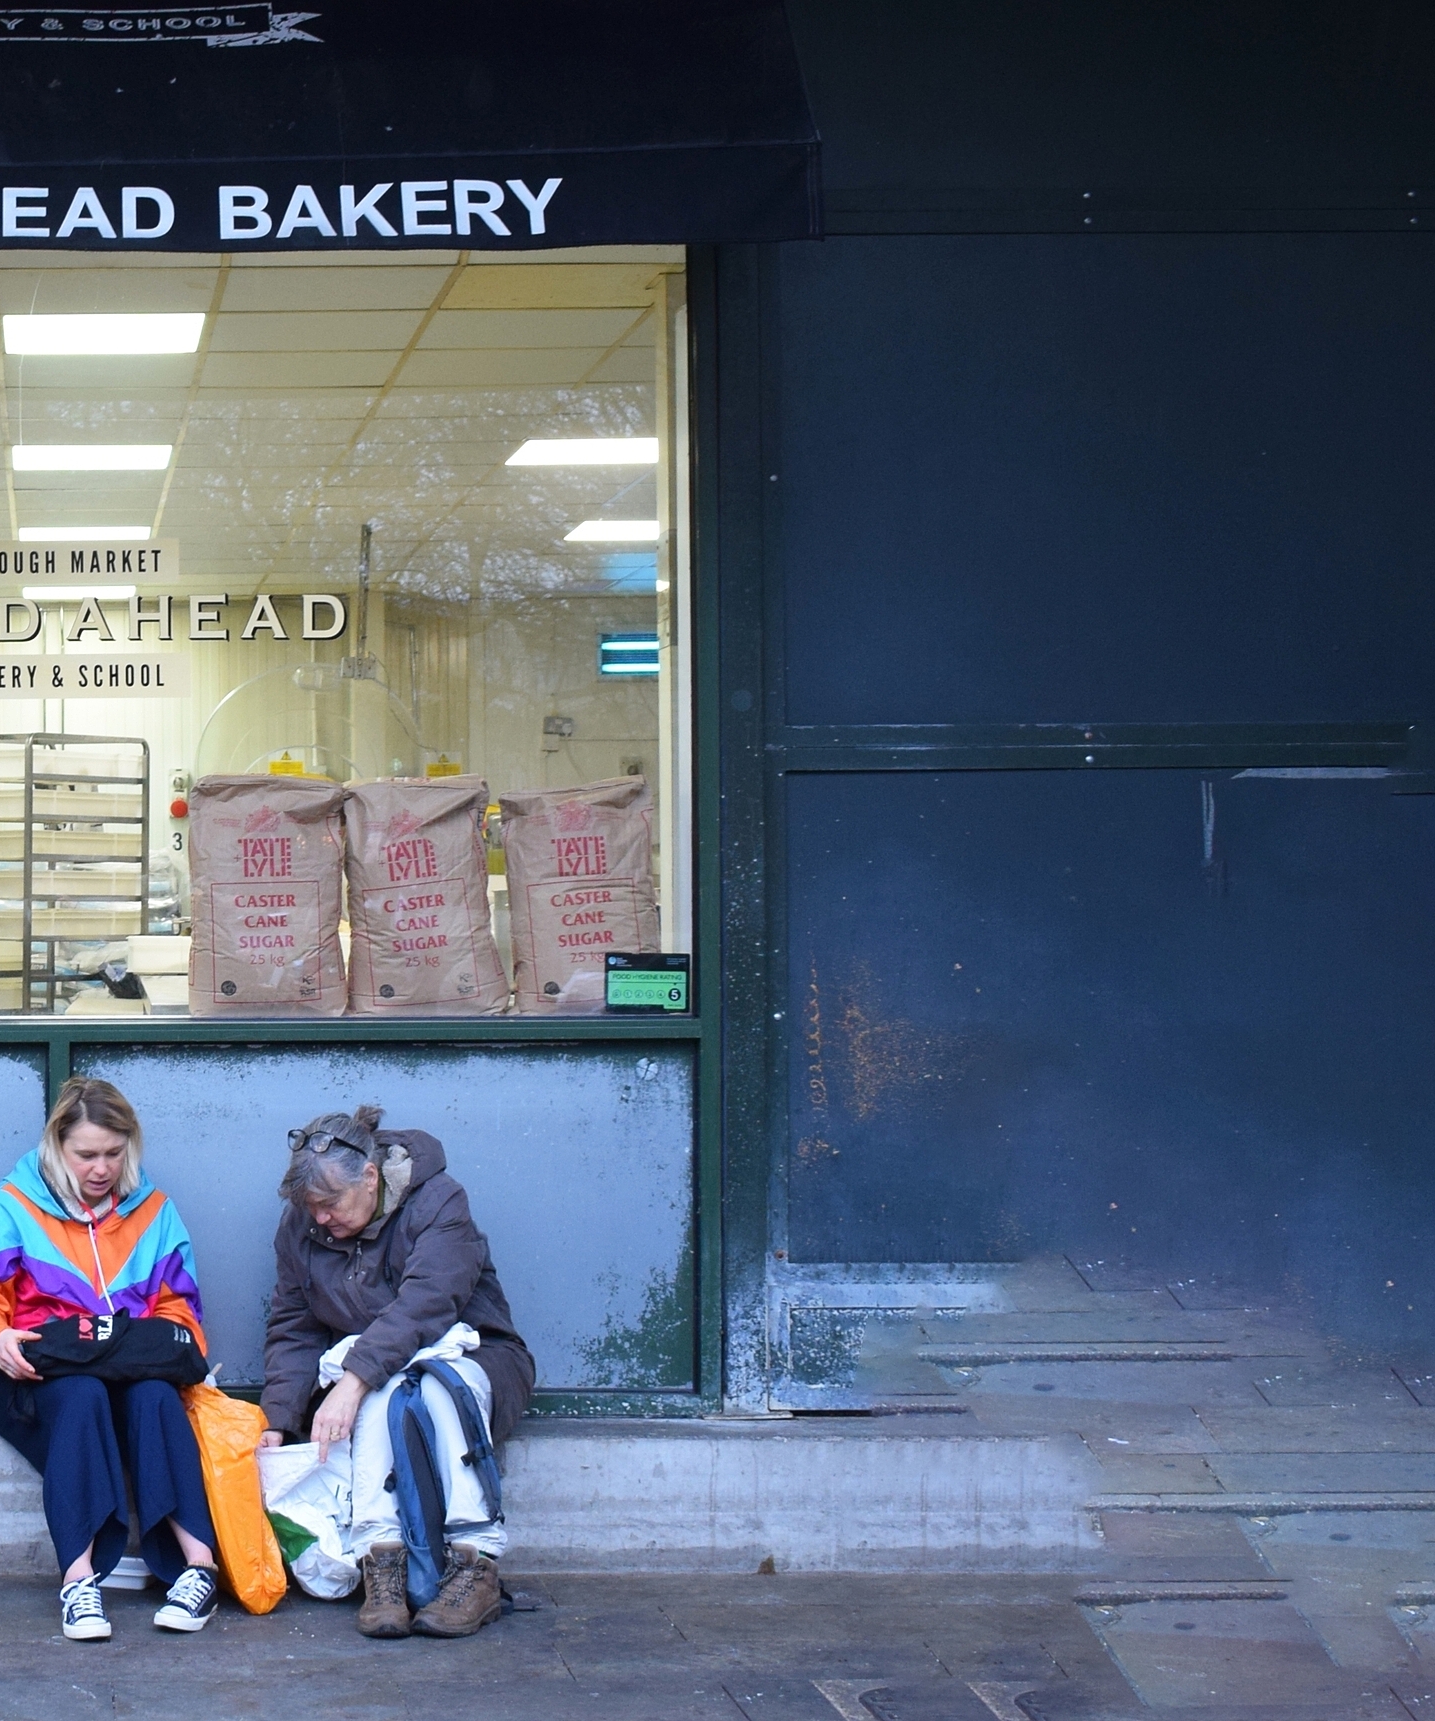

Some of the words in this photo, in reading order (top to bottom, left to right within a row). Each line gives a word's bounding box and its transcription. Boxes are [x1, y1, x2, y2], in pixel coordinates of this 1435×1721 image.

[41, 18, 64, 31] &
[82, 15, 246, 31] SCHOOL
[219, 178, 563, 240] BAKERY
[70, 549, 163, 574] MARKET
[67, 593, 347, 643] AHEAD
[51, 665, 64, 688] &
[78, 663, 166, 688] SCHOOL
[172, 832, 183, 851] 3
[238, 838, 291, 857] TATE
[381, 838, 435, 862] TATE
[551, 836, 605, 856] TATE
[243, 858, 292, 877] LYLE
[388, 857, 437, 881] LYLE
[557, 855, 607, 877] LYLE
[234, 894, 296, 908] CASTER
[383, 894, 446, 913] CASTER
[550, 890, 613, 907] CASTER
[244, 915, 288, 928] CANE
[395, 915, 439, 932] CANE
[561, 910, 606, 926] CANE
[239, 935, 295, 948] SUGAR
[392, 934, 449, 952] SUGAR
[558, 930, 615, 948] SUGAR
[250, 954, 266, 965] 25
[270, 954, 285, 967] kg
[405, 956, 421, 968] 25
[424, 955, 441, 968] kg
[570, 951, 587, 963] 25
[590, 951, 605, 963] kg
[670, 989, 679, 1000] 5
